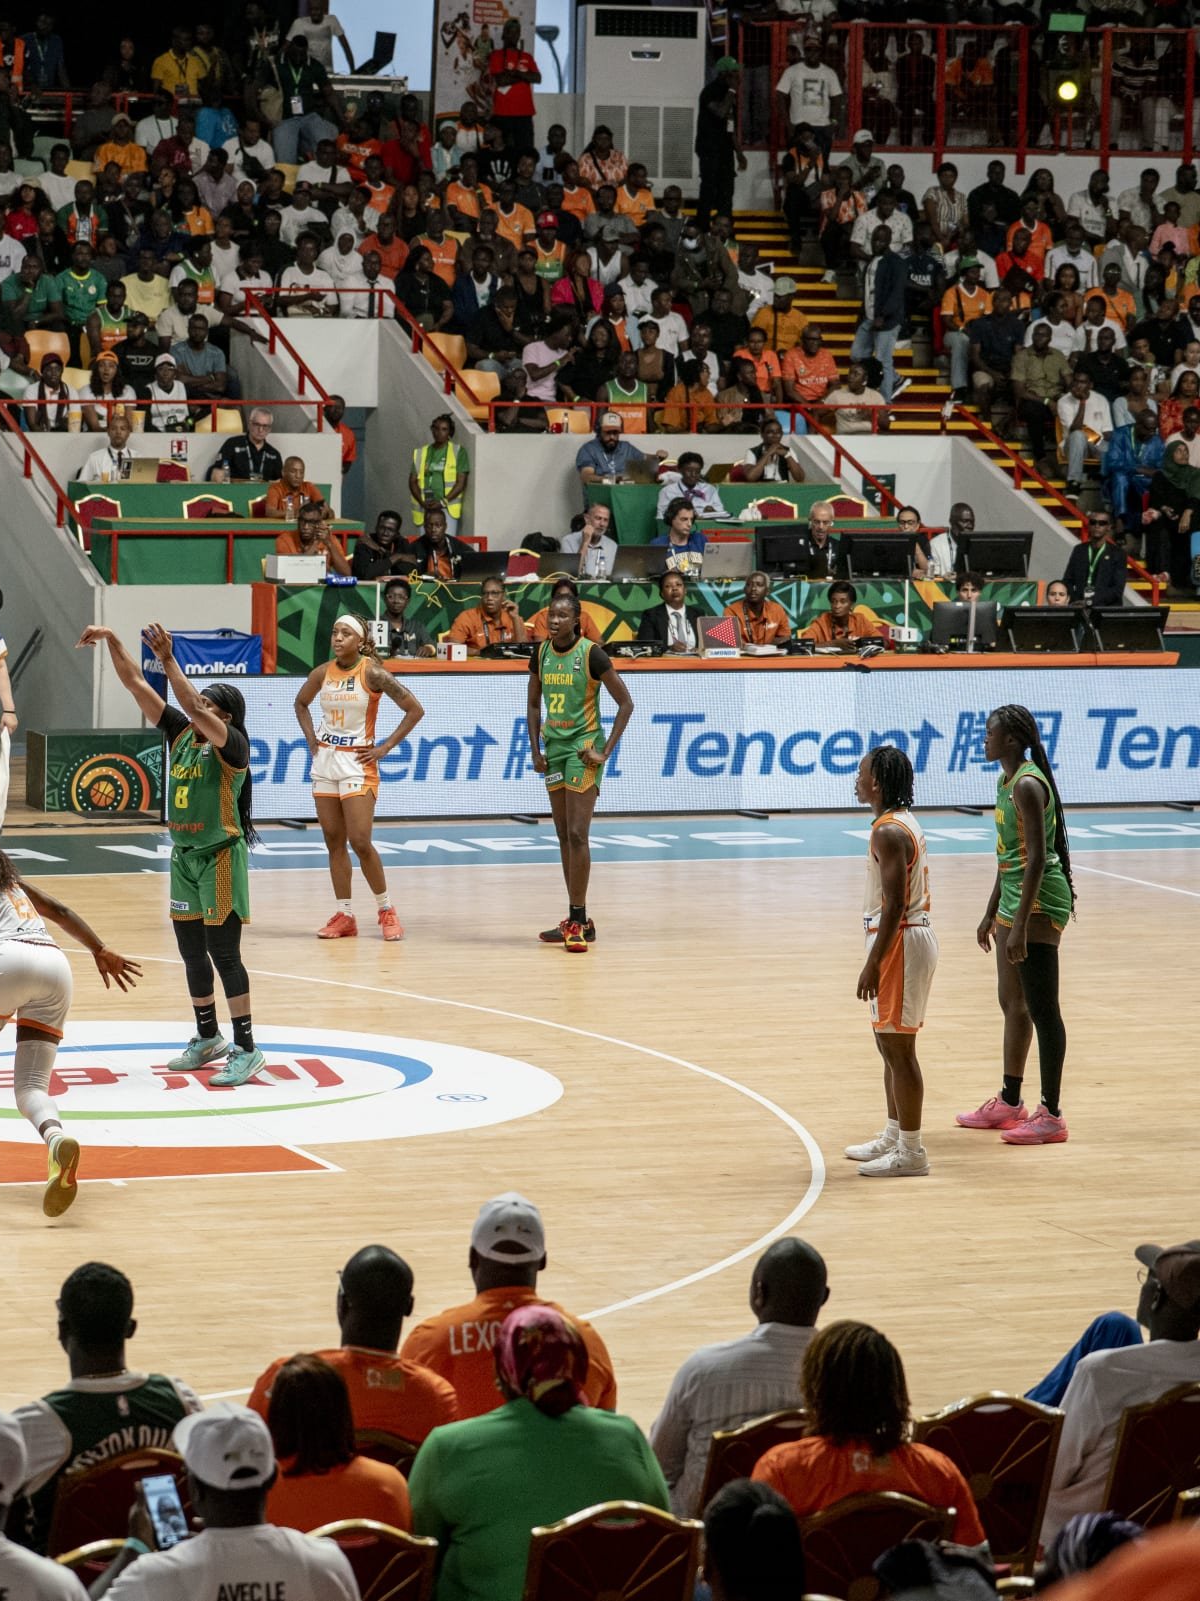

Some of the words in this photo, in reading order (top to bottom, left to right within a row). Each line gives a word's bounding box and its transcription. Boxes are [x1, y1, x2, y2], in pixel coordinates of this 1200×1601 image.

[185, 661, 247, 675] molten
[544, 673, 573, 685] SENEGAL
[549, 693, 565, 713] 22
[330, 706, 345, 729] 14
[175, 786, 188, 809] 8
[217, 1582, 261, 1601] AVEC
[265, 1582, 286, 1601] LE
